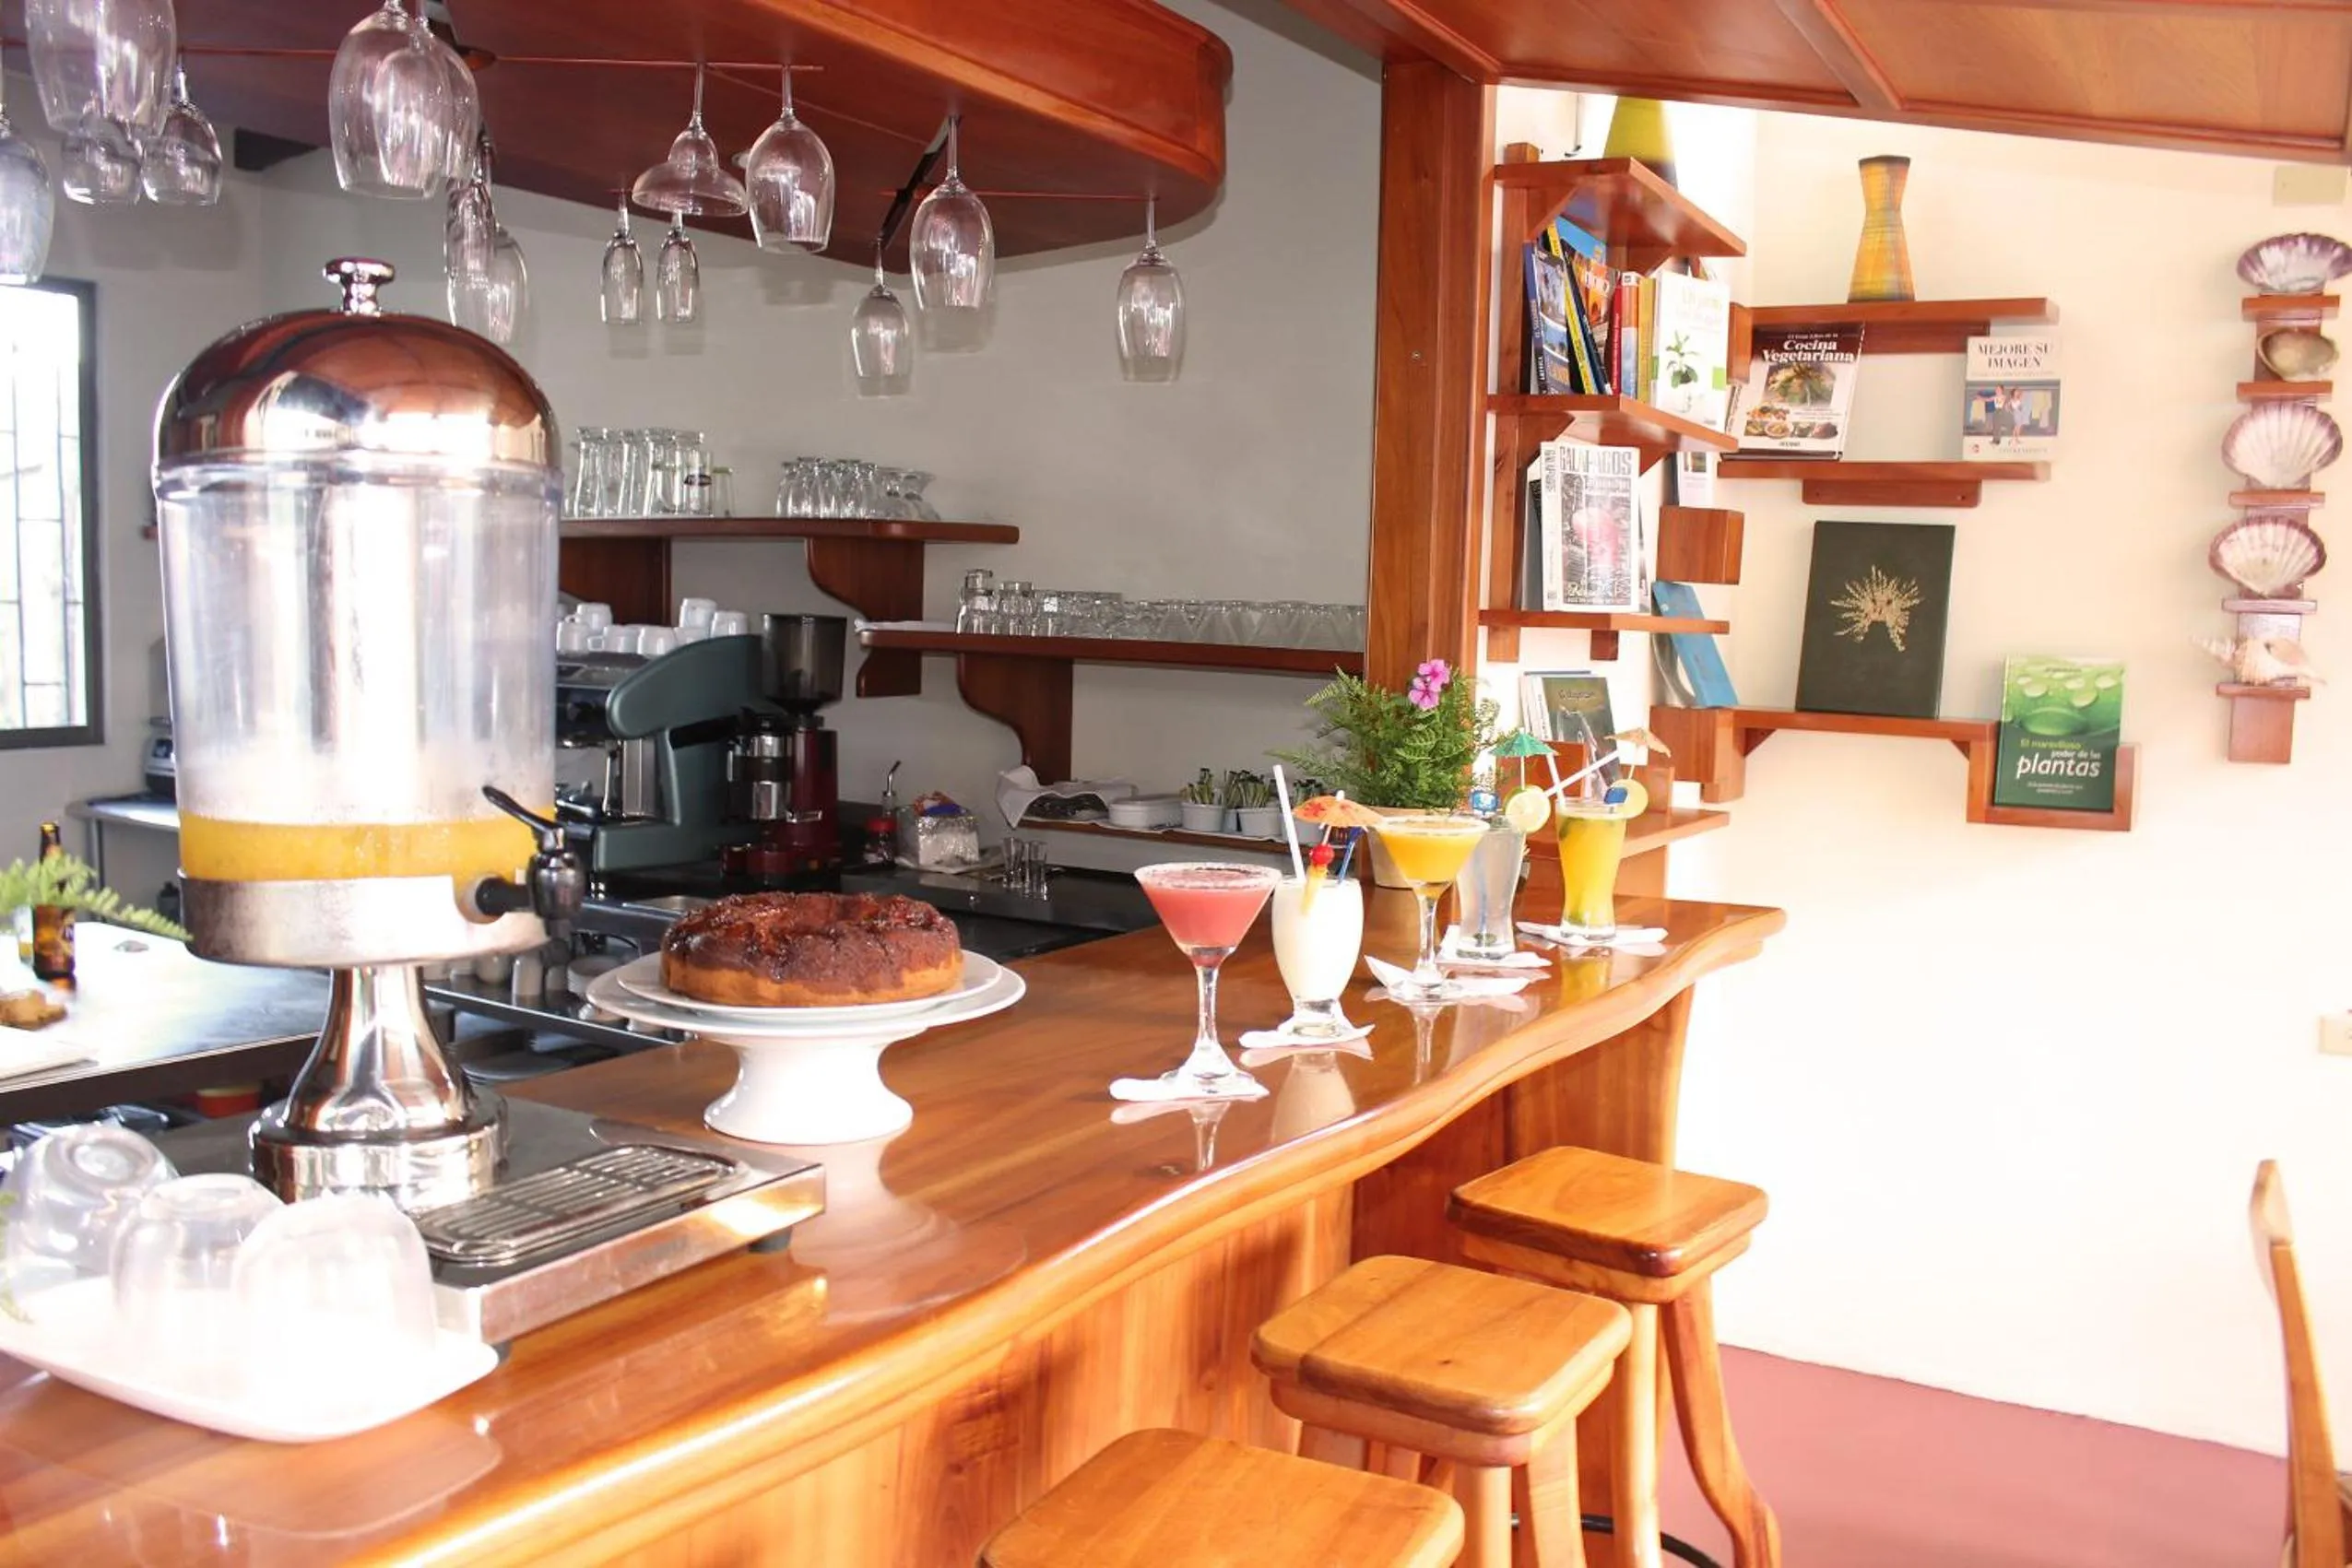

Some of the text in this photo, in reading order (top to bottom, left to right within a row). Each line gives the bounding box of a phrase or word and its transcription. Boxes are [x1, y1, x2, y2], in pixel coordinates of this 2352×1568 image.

[1783, 339, 1838, 351] Cocina
[1978, 342, 2031, 356] MEJORE
[1763, 349, 1854, 363] Vegetariana
[1988, 357, 2042, 369] IMAGEN
[2020, 738, 2030, 749] El
[2077, 749, 2089, 759] de
[2015, 751, 2101, 780] plantas
